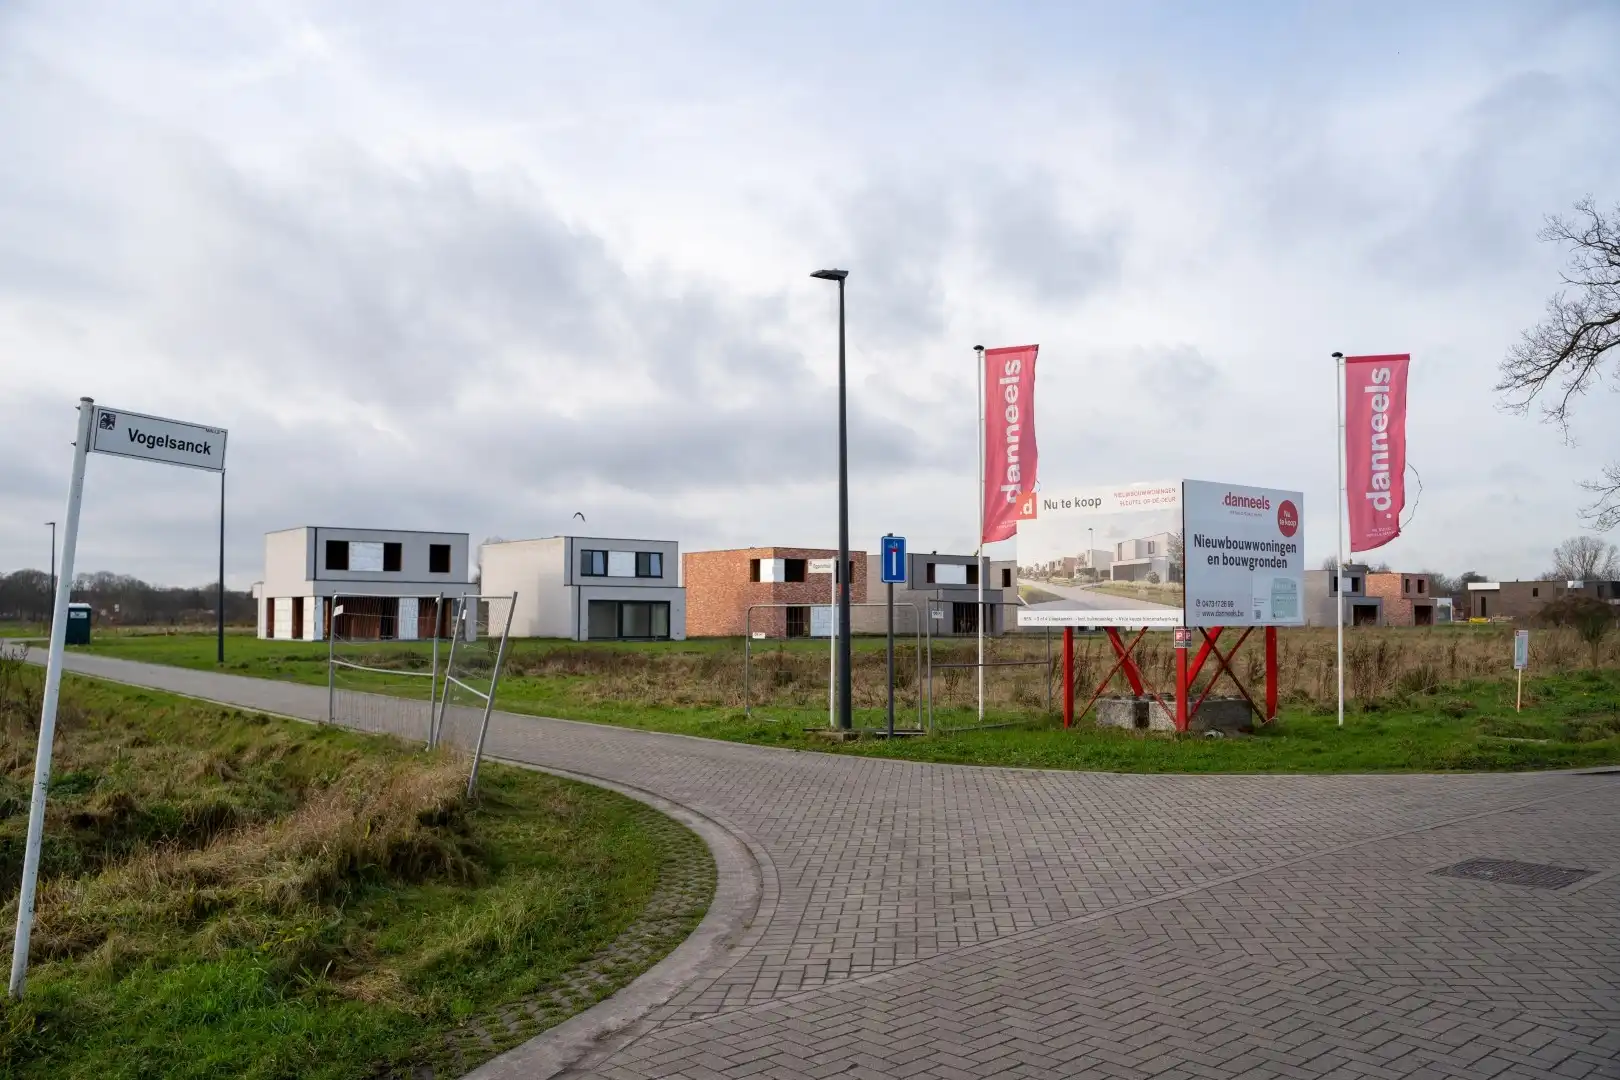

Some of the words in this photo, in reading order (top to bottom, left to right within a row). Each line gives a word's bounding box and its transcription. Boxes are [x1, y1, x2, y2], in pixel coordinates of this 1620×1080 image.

[999, 359, 1021, 503] danneels
[128, 427, 211, 455] Vogelsanck
[1044, 499, 1058, 510] Nu
[1061, 498, 1072, 509] te
[1074, 496, 1102, 509] koop
[1283, 510, 1291, 518] Nu
[1285, 518, 1297, 528] koop
[1194, 533, 1297, 556] Nieuwbouwwoningen
[1207, 554, 1220, 566] en
[1222, 552, 1288, 571] bouwgronden
